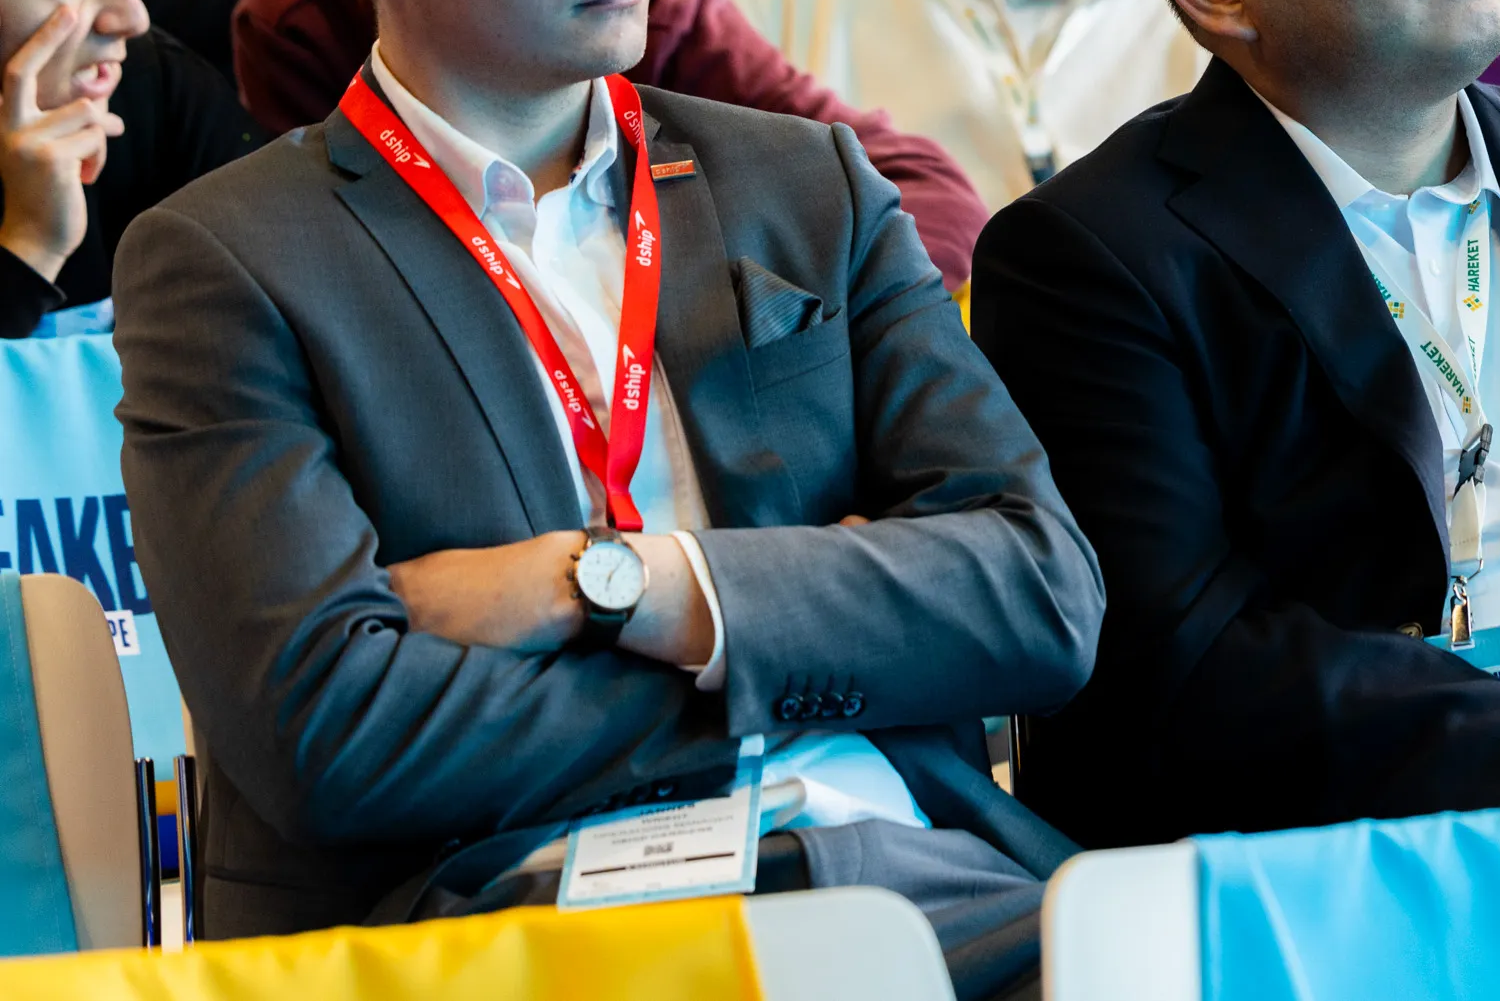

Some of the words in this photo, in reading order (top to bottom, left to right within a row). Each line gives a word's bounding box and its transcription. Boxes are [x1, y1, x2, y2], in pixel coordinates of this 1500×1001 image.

[379, 129, 412, 164] dship
[471, 235, 504, 276] dship
[635, 229, 656, 267] dship
[1467, 239, 1480, 293] HAREKET
[623, 363, 646, 411] dship
[1420, 340, 1466, 397] HAREKET
[554, 369, 582, 414] dship
